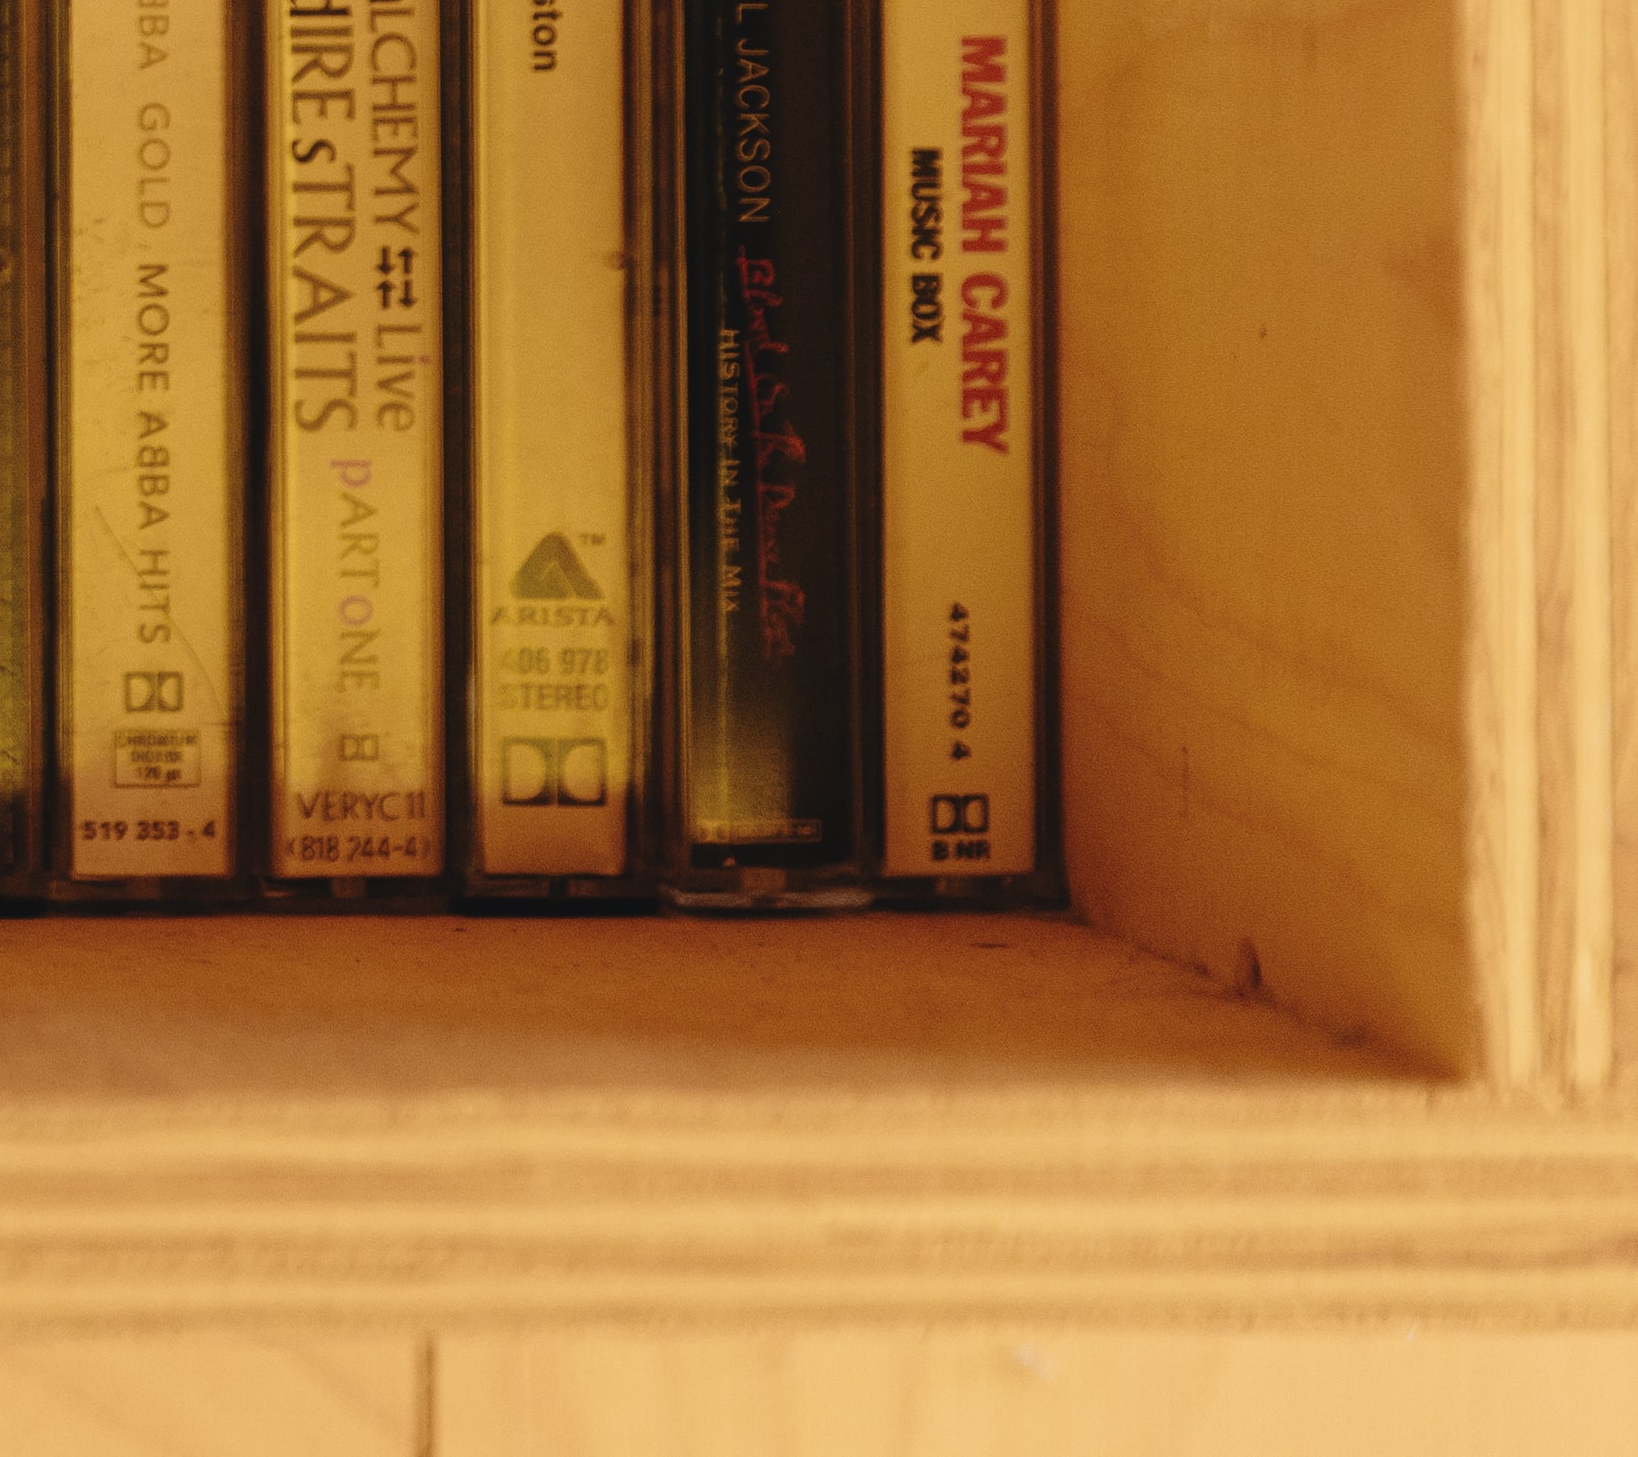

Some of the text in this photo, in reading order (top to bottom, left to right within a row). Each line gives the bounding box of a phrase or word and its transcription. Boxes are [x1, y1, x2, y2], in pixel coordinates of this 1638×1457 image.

[137, 103, 171, 229] GOLD
[737, 39, 770, 222] JACKSON
[911, 150, 941, 343] MUSIC BOX
[962, 37, 1009, 454] MARIAH CAREY
[137, 264, 169, 390] MORE
[137, 411, 169, 529] ABBA
[137, 550, 171, 643] HITS
